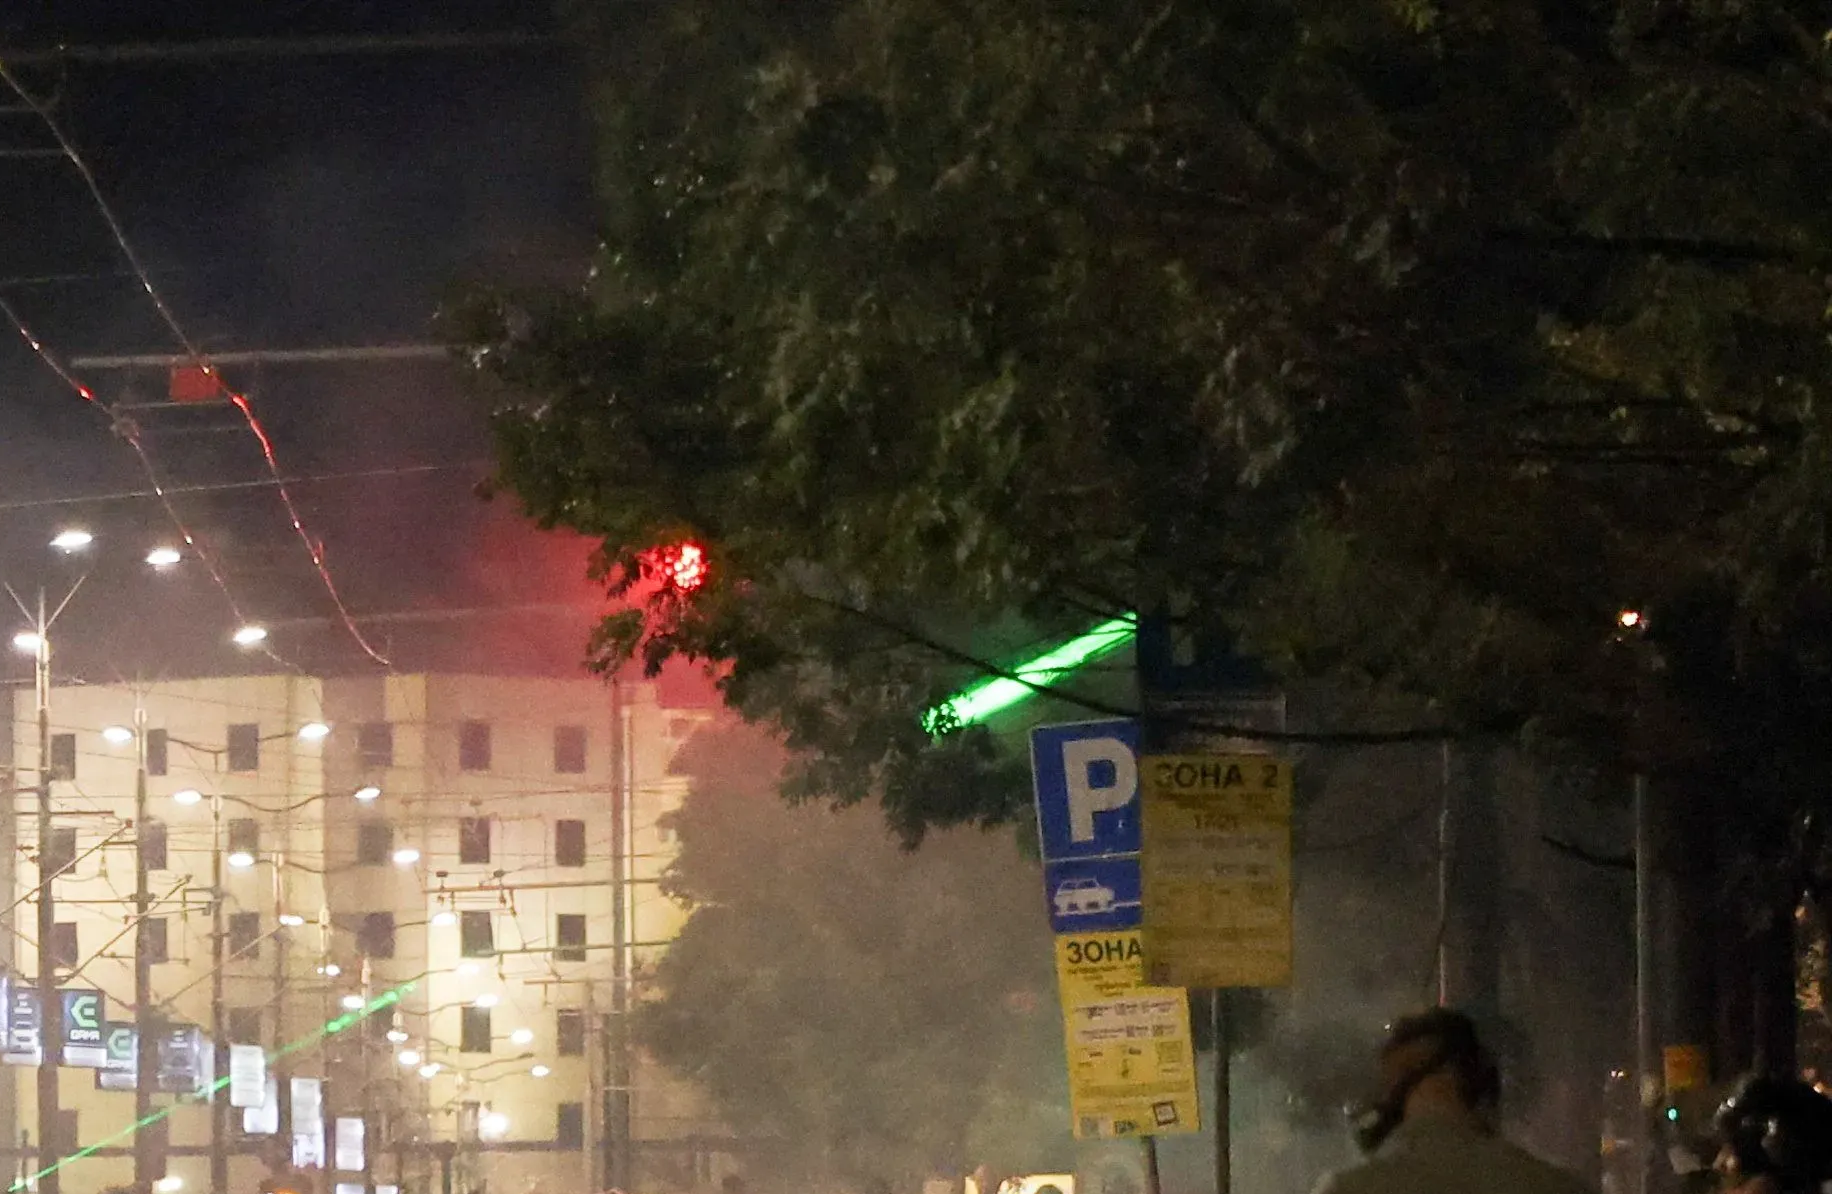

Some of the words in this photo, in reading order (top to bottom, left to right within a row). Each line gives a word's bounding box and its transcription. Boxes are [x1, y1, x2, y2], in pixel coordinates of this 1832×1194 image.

[1153, 762, 1245, 789] ЗОНА
[1261, 764, 1278, 788] 2
[1061, 736, 1139, 844] P
[1066, 938, 1142, 965] ЗОНА
